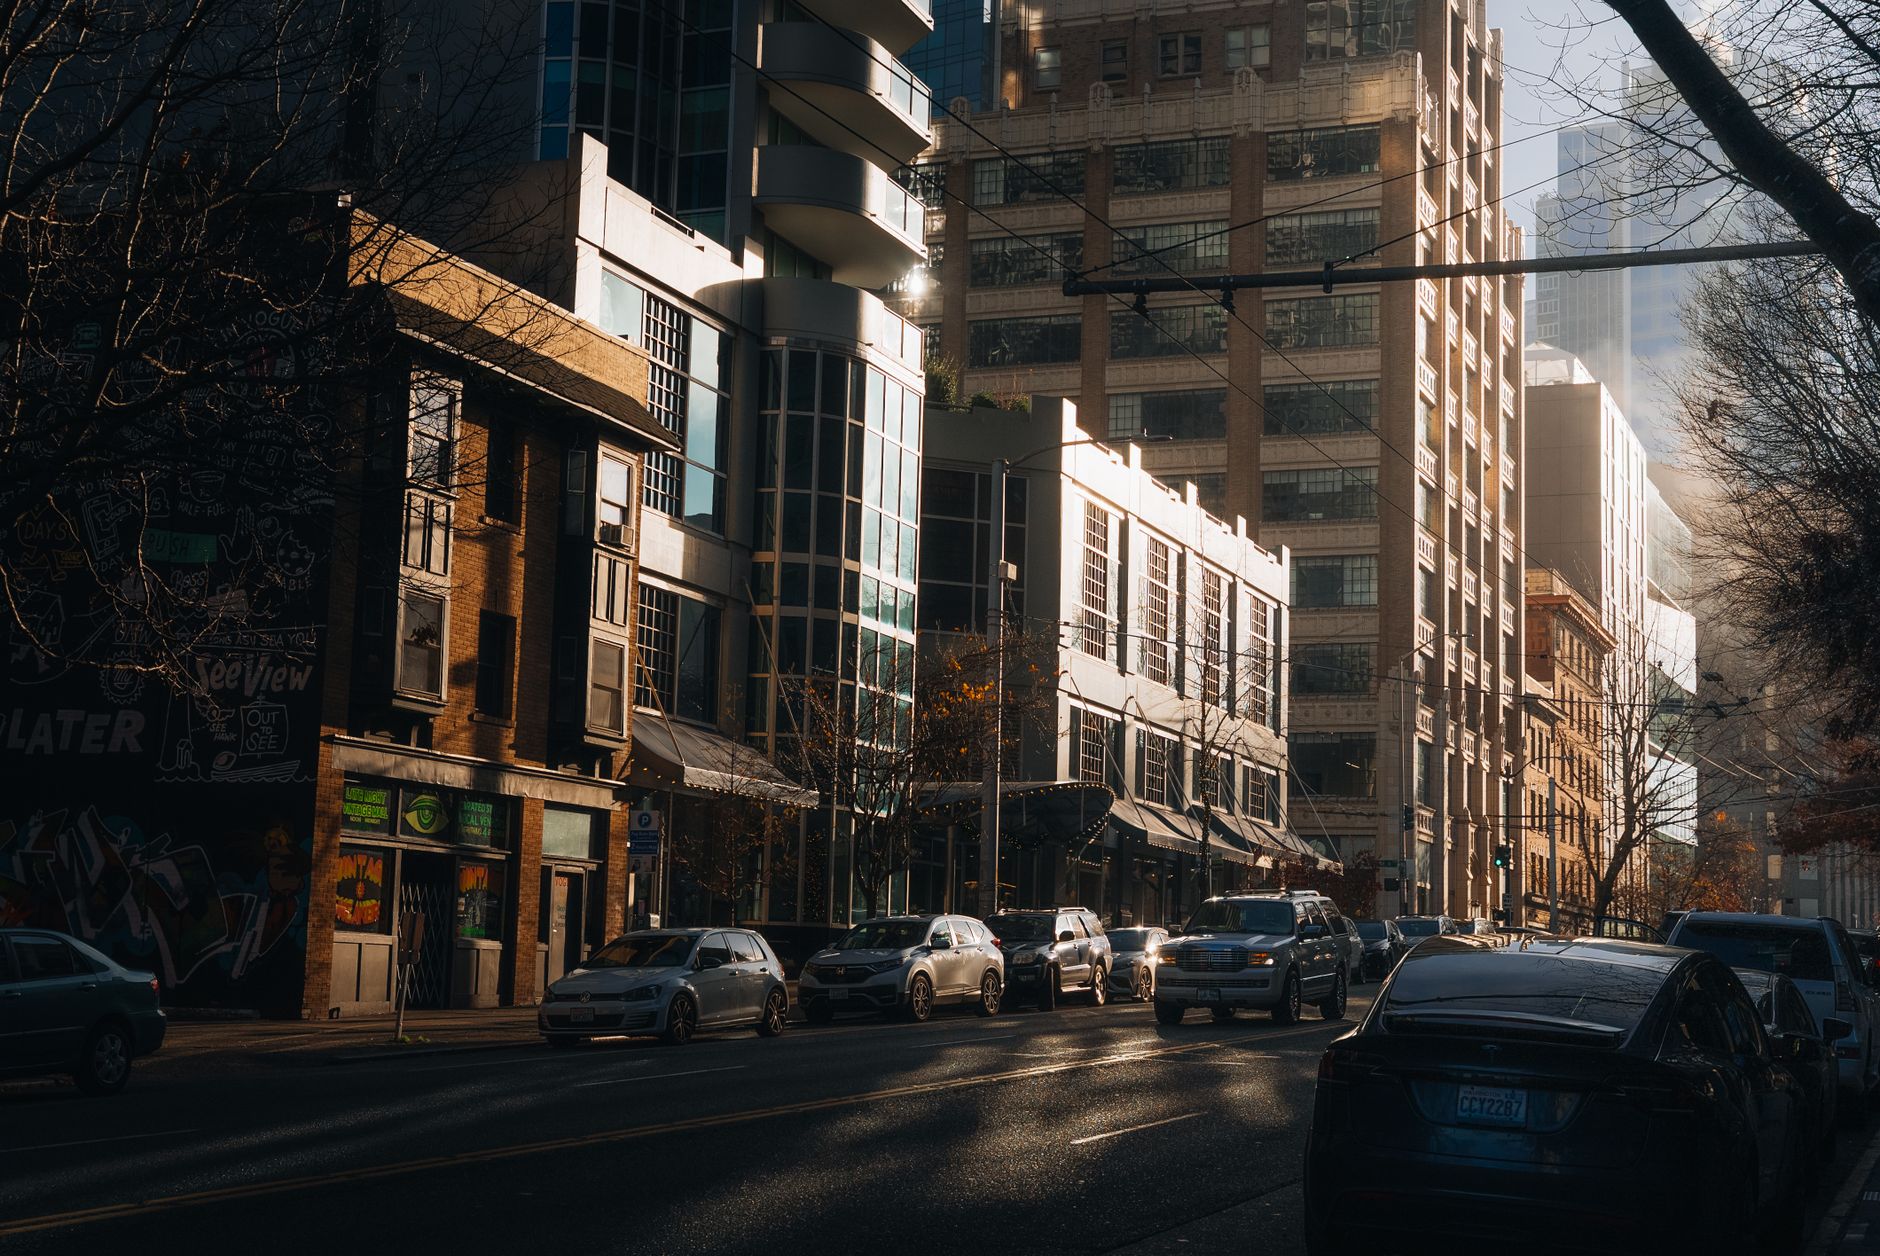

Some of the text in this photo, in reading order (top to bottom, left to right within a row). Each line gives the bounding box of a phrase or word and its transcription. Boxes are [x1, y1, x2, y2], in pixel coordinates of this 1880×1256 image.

[247, 709, 280, 727] OUT
[6, 708, 145, 755] LATER
[261, 727, 272, 735] TO
[246, 732, 280, 751] SEE
[1460, 1096, 1523, 1118] CCY2287
